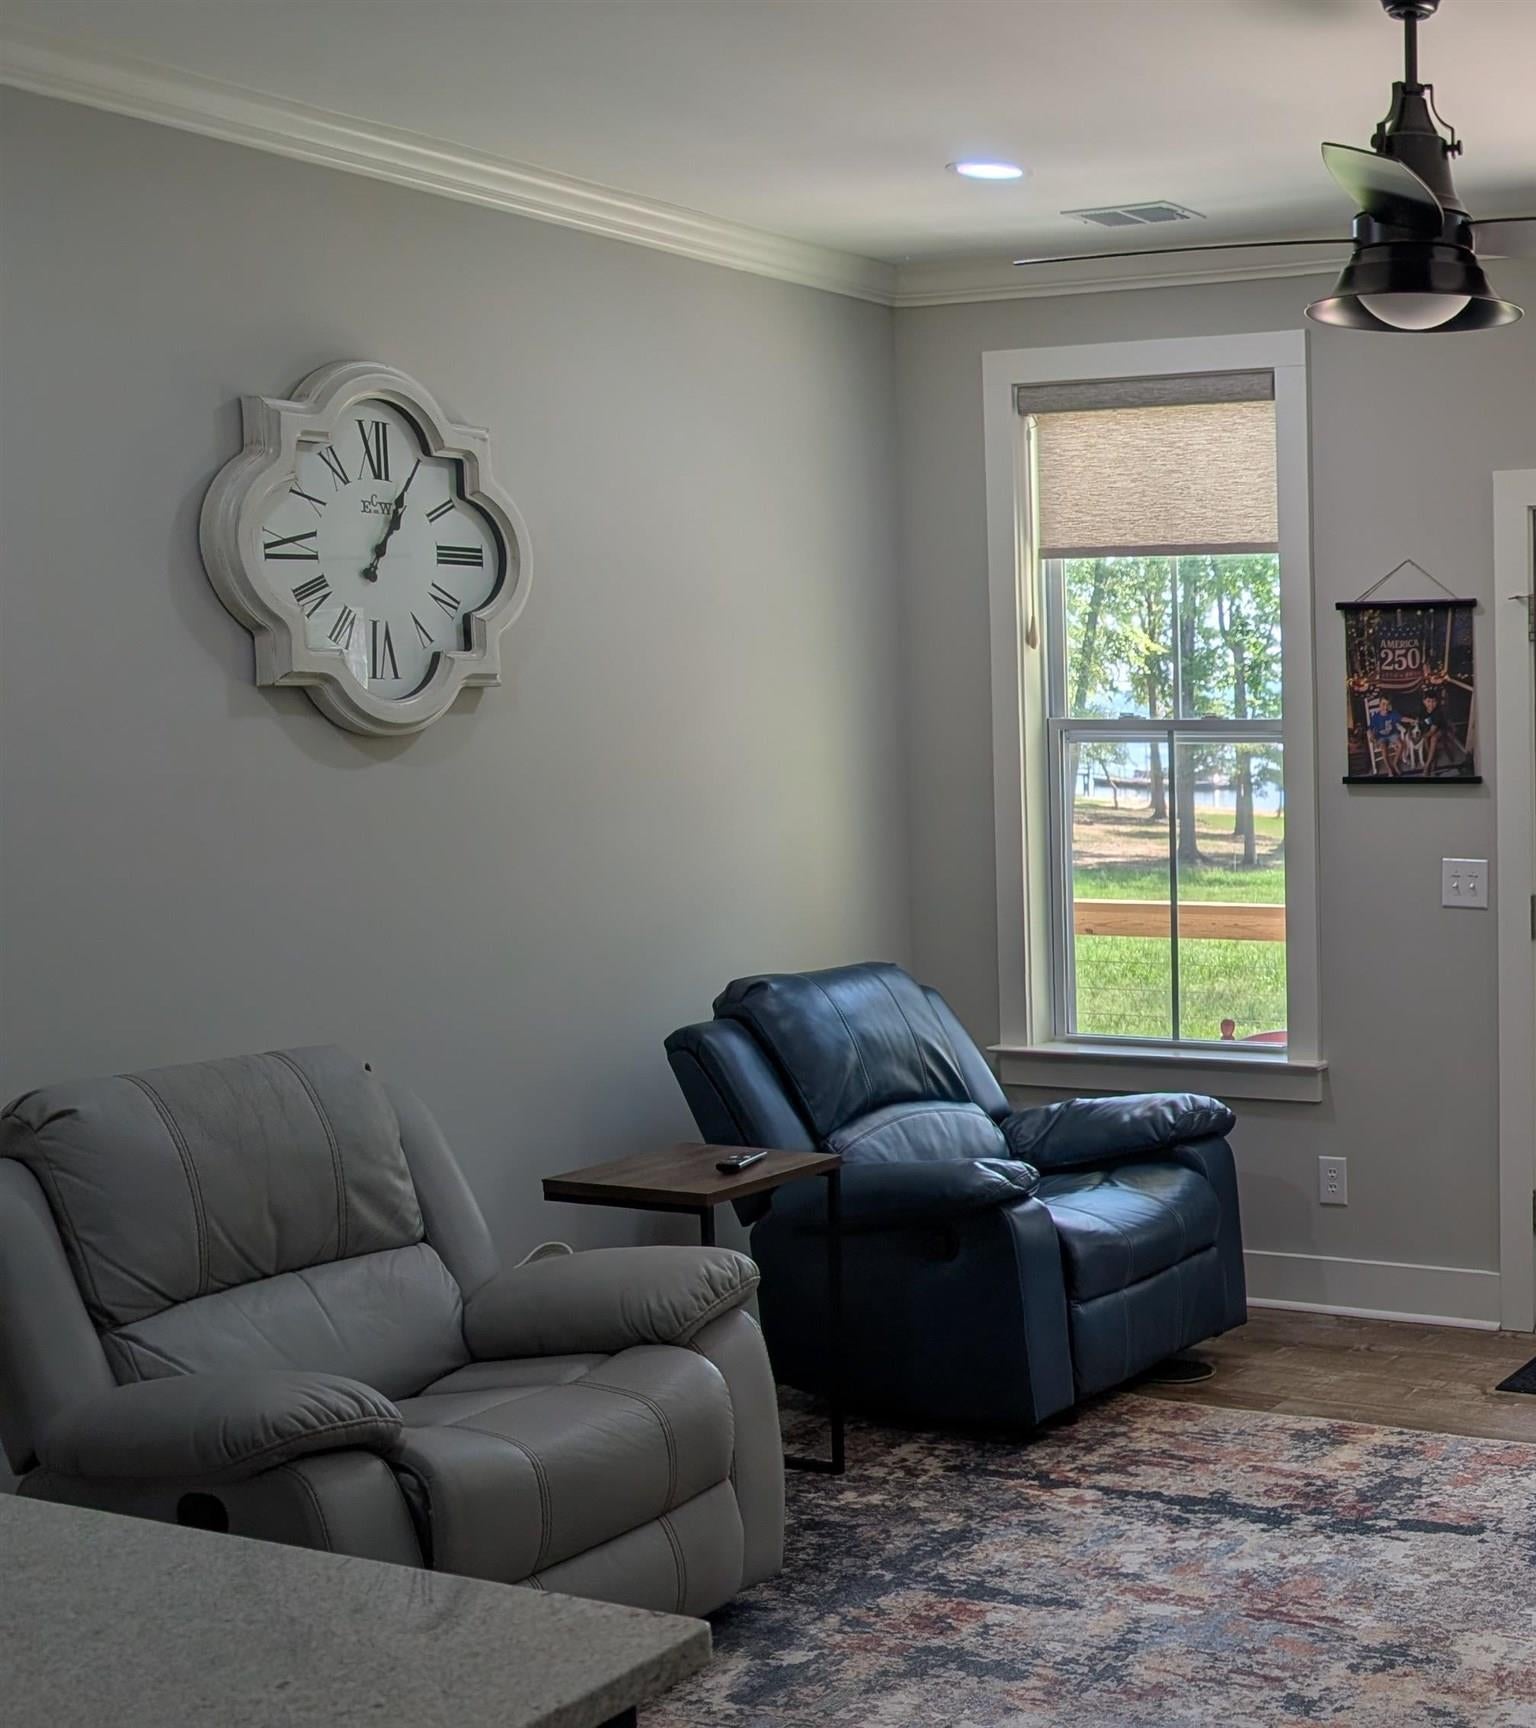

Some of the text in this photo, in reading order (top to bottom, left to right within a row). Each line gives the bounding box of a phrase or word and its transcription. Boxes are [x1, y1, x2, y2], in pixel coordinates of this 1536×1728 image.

[355, 419, 392, 482] XII
[1380, 639, 1420, 649] AMERICA
[1380, 648, 1421, 671] 250
